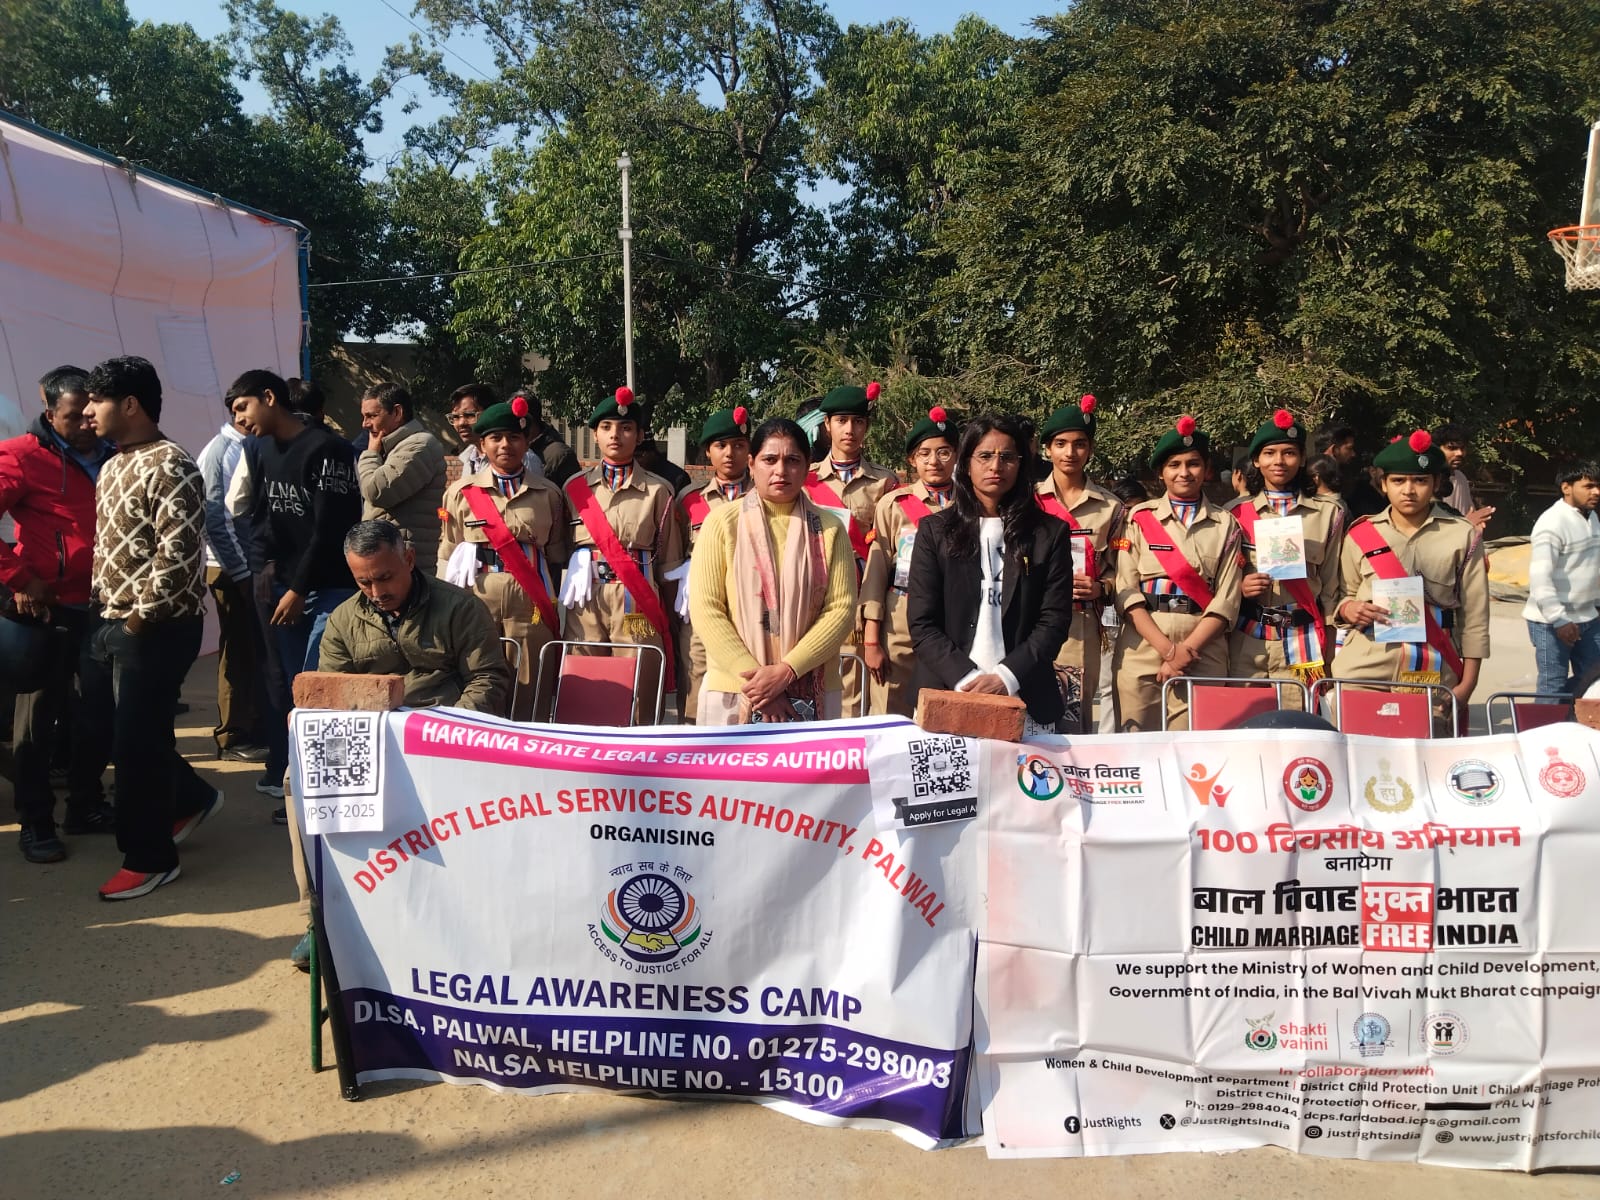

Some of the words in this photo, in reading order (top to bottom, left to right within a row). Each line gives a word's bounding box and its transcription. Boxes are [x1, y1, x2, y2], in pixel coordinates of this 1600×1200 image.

[422, 720, 519, 752] HARYANA
[524, 738, 588, 760] STATE
[591, 747, 659, 766] LEGAL
[664, 751, 769, 767] SERVICES
[1062, 764, 1091, 779] बाल
[1094, 764, 1141, 779] विवाह
[1097, 780, 1143, 795] भारत
[909, 810, 932, 822] Apply
[933, 808, 945, 818] for
[947, 806, 968, 817] Legal
[590, 824, 715, 847] ORGANISING
[1197, 829, 1258, 854] 100
[1265, 822, 1384, 854] दिवसीय
[1391, 822, 1520, 851] अभियान
[353, 811, 461, 894] DISTRICT
[465, 792, 553, 830] LEGAL
[557, 787, 692, 816] SERVICES
[698, 794, 859, 856] AUTHORITY,
[862, 837, 947, 928] PALWAL
[1324, 852, 1393, 871] बनायेगा
[609, 863, 633, 878] न्याय
[638, 861, 655, 871] सब
[659, 860, 670, 874] के
[673, 865, 693, 884] लिए
[1192, 886, 1266, 915] बाल
[1272, 878, 1359, 914] विवाह
[1364, 885, 1432, 922] मुक्त
[1437, 887, 1519, 914] भारत
[1191, 925, 1249, 948] CHILD
[1254, 925, 1359, 948] MARRIAGE
[1365, 923, 1431, 949] FREE
[1437, 923, 1518, 946] INDIA
[587, 922, 618, 962] ACCESS
[620, 957, 633, 971] TO
[635, 960, 681, 975] JUSTICE
[681, 948, 702, 967] FOR
[699, 929, 714, 951] ALL
[1116, 962, 1141, 975] We
[1146, 962, 1208, 978] support
[1211, 961, 1238, 975] the
[1242, 961, 1307, 979] Ministry
[1312, 961, 1327, 975] of
[1332, 962, 1397, 976] Women
[1401, 962, 1433, 976] and
[1437, 962, 1479, 976] Child
[1483, 960, 1600, 977] Development,
[411, 967, 519, 1006] LEGAL
[526, 976, 750, 1014] AWARENESS
[760, 985, 862, 1022] CAMP
[1109, 986, 1210, 999] Government
[1214, 984, 1230, 998] of
[1234, 985, 1280, 1000] India,
[1284, 985, 1299, 998] in
[1302, 985, 1328, 999] the
[1333, 986, 1358, 999] Bal
[1364, 986, 1411, 999] Vivah
[1415, 986, 1456, 999] Mukt
[1460, 985, 1516, 998] Bharat
[1279, 1022, 1327, 1036] shakti
[354, 1000, 426, 1035] DLSA,
[432, 1014, 543, 1052] PALWAL,
[551, 1028, 685, 1058] HELPLINE
[692, 1033, 739, 1061] NO.
[748, 1036, 952, 1089] 01275-298003
[1280, 1037, 1328, 1050] vahini
[454, 1048, 541, 1076] NALSA
[547, 1057, 677, 1089] HELPLINE
[685, 1070, 732, 1091] NO.
[759, 1068, 843, 1100] 15100
[1045, 1057, 1085, 1070] Women
[1089, 1059, 1098, 1069] &
[1102, 1059, 1132, 1073] Child
[1136, 1065, 1213, 1084] Development
[1216, 1076, 1290, 1088] Department
[1300, 1081, 1344, 1092] District
[1348, 1082, 1378, 1092] Child
[1382, 1081, 1448, 1096] Protection
[1452, 1084, 1478, 1095] Unit
[1488, 1084, 1520, 1095] Child
[1279, 1067, 1293, 1076] In
[1298, 1065, 1397, 1078] collaboration
[1402, 1065, 1434, 1077] with
[1185, 1099, 1204, 1111] Ph:
[1216, 1088, 1263, 1098] District
[1265, 1091, 1300, 1105] Child
[1302, 1097, 1369, 1107] Protection
[1372, 1099, 1420, 1111] Officer,
[1083, 1116, 1142, 1129] JustRights
[1180, 1116, 1290, 1131] @JustRightsIndia
[1326, 1127, 1422, 1140] justrightsindia
